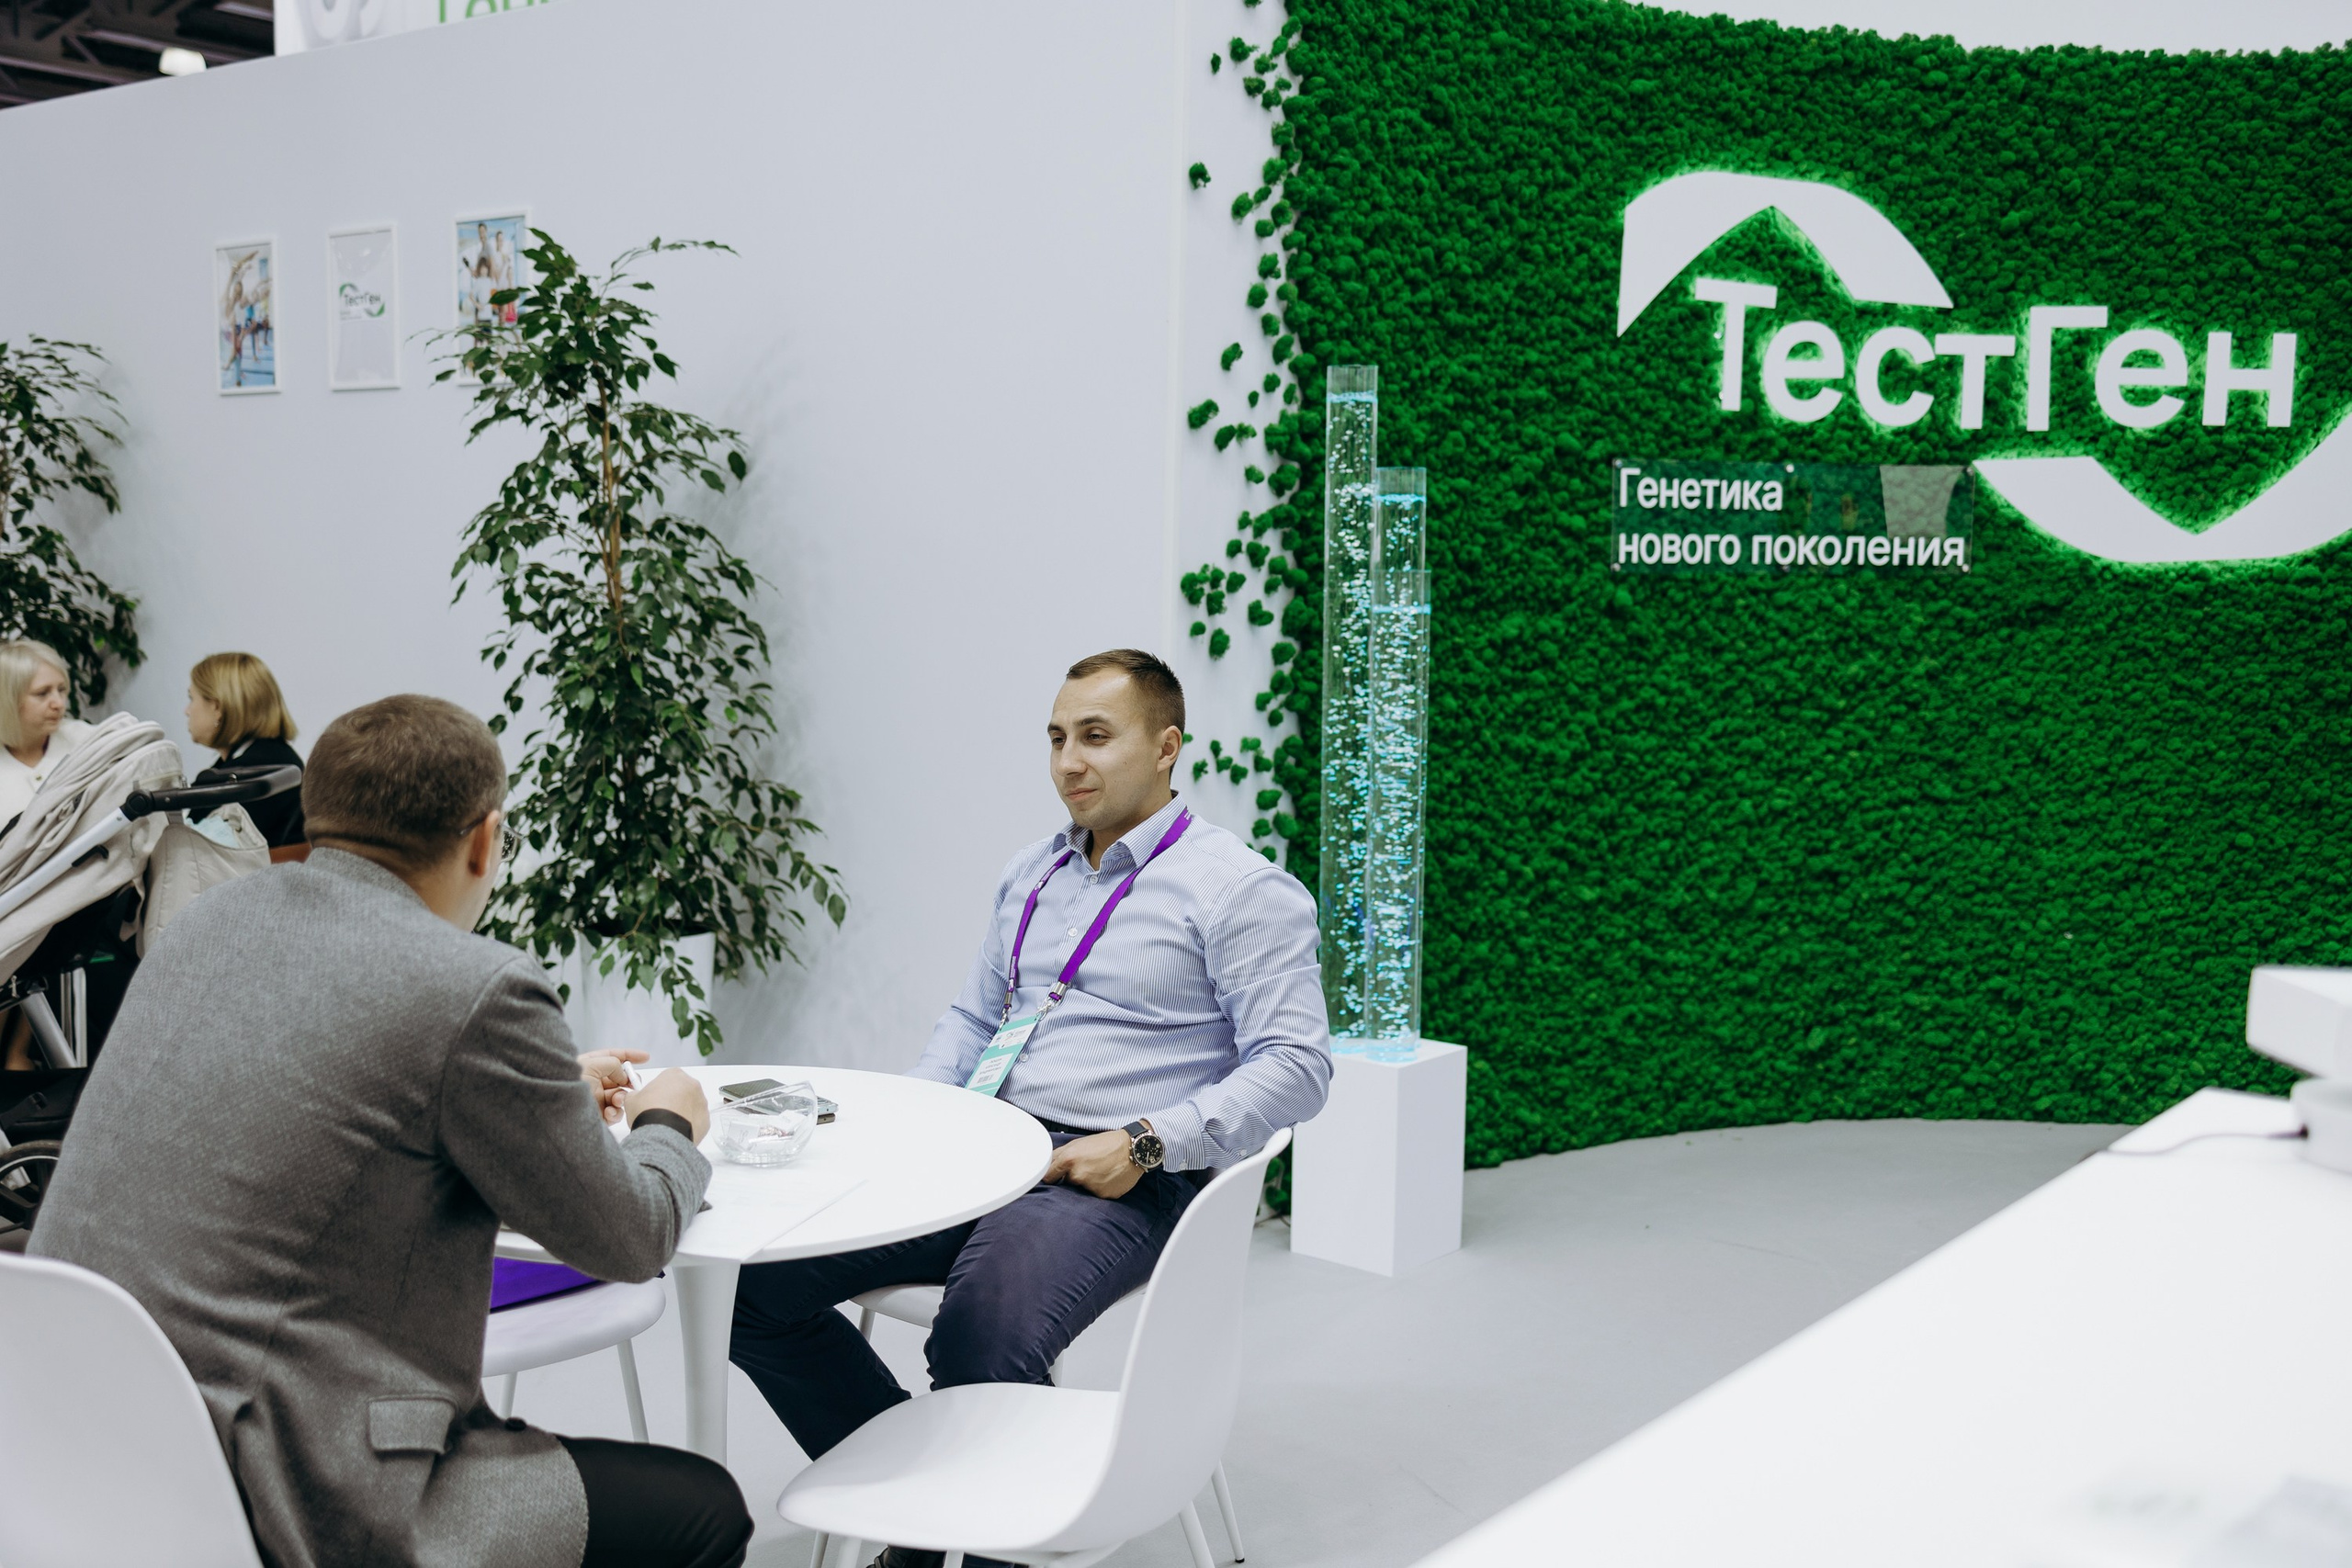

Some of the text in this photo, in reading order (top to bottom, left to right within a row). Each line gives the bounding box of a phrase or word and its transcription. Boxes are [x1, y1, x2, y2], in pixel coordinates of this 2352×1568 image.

[1694, 277, 2297, 432] ТестГен
[1619, 468, 1783, 511] Генетика
[1618, 532, 1964, 566] нового поколения
